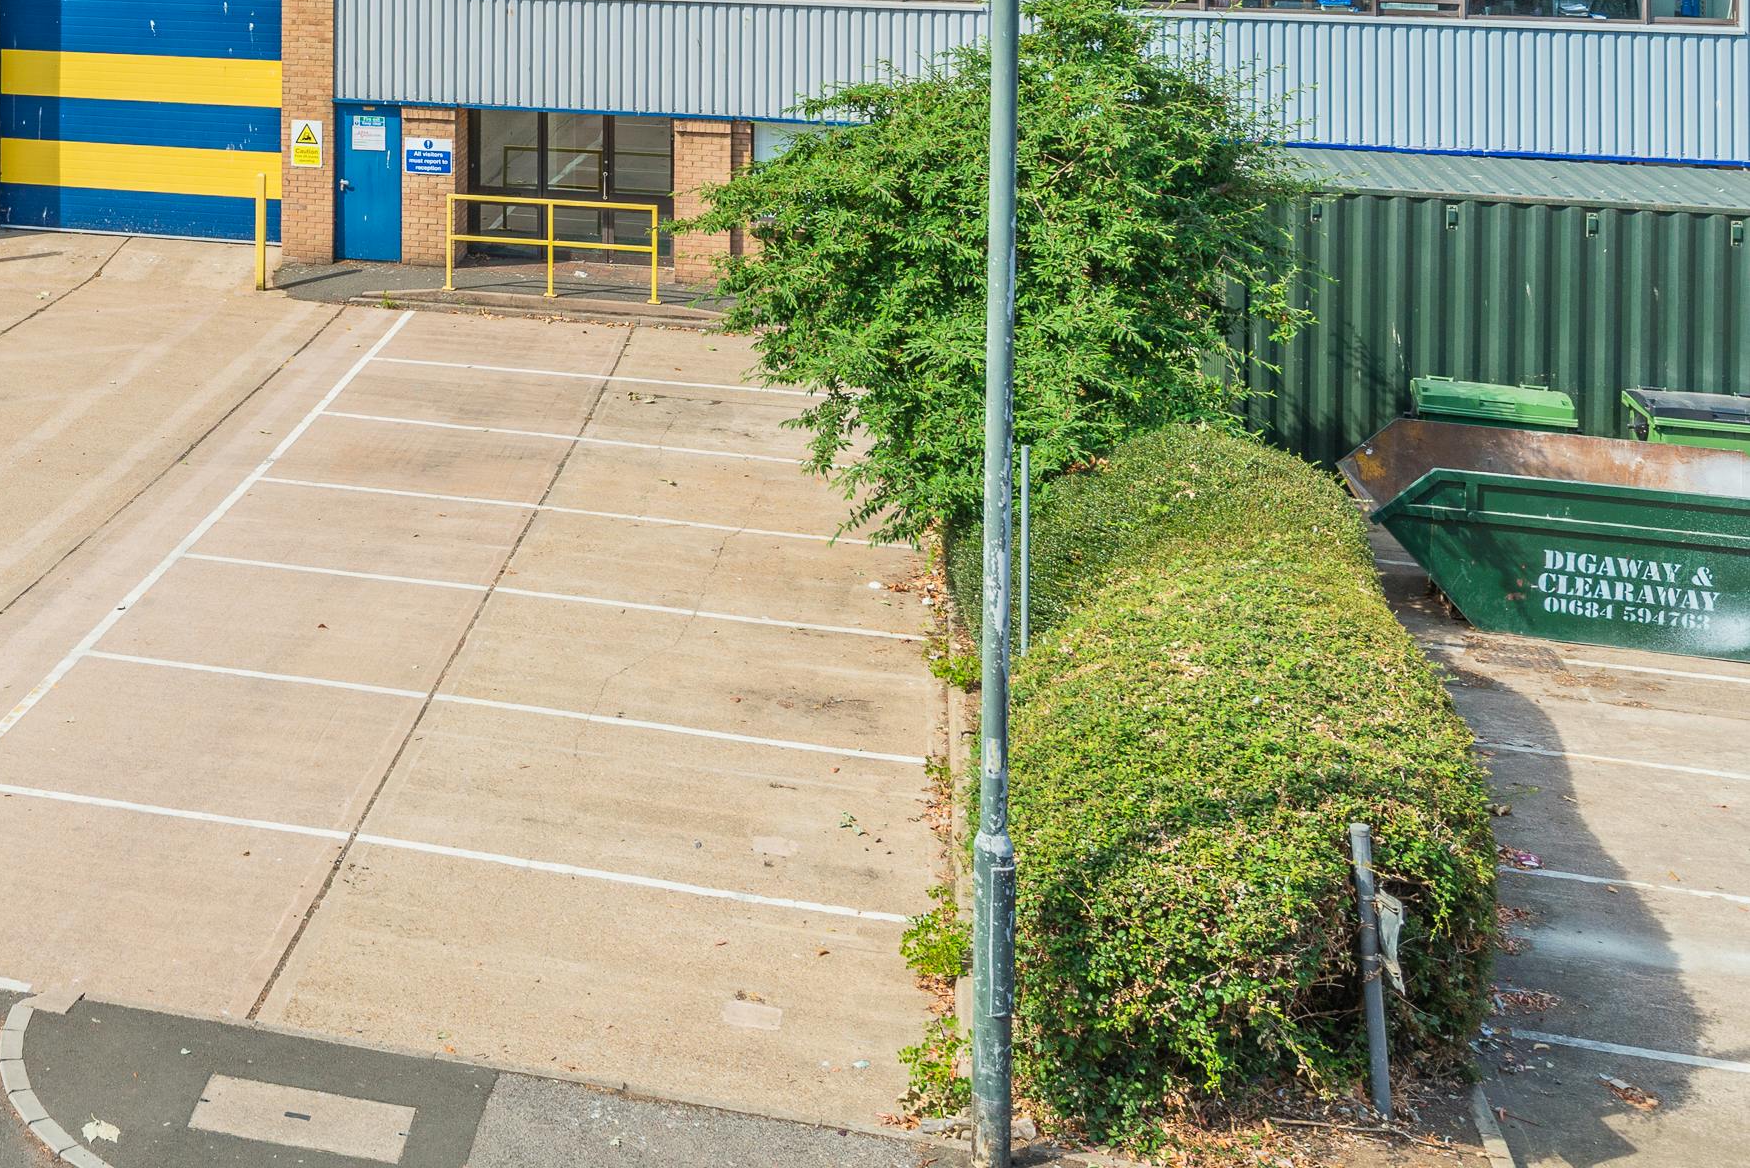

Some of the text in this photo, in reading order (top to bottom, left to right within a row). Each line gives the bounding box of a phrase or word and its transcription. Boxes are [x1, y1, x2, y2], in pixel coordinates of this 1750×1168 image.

[1543, 549, 1714, 587] DIGAWAY &
[1537, 573, 1720, 612] CLEARAWAY
[1543, 596, 1614, 620] 01684
